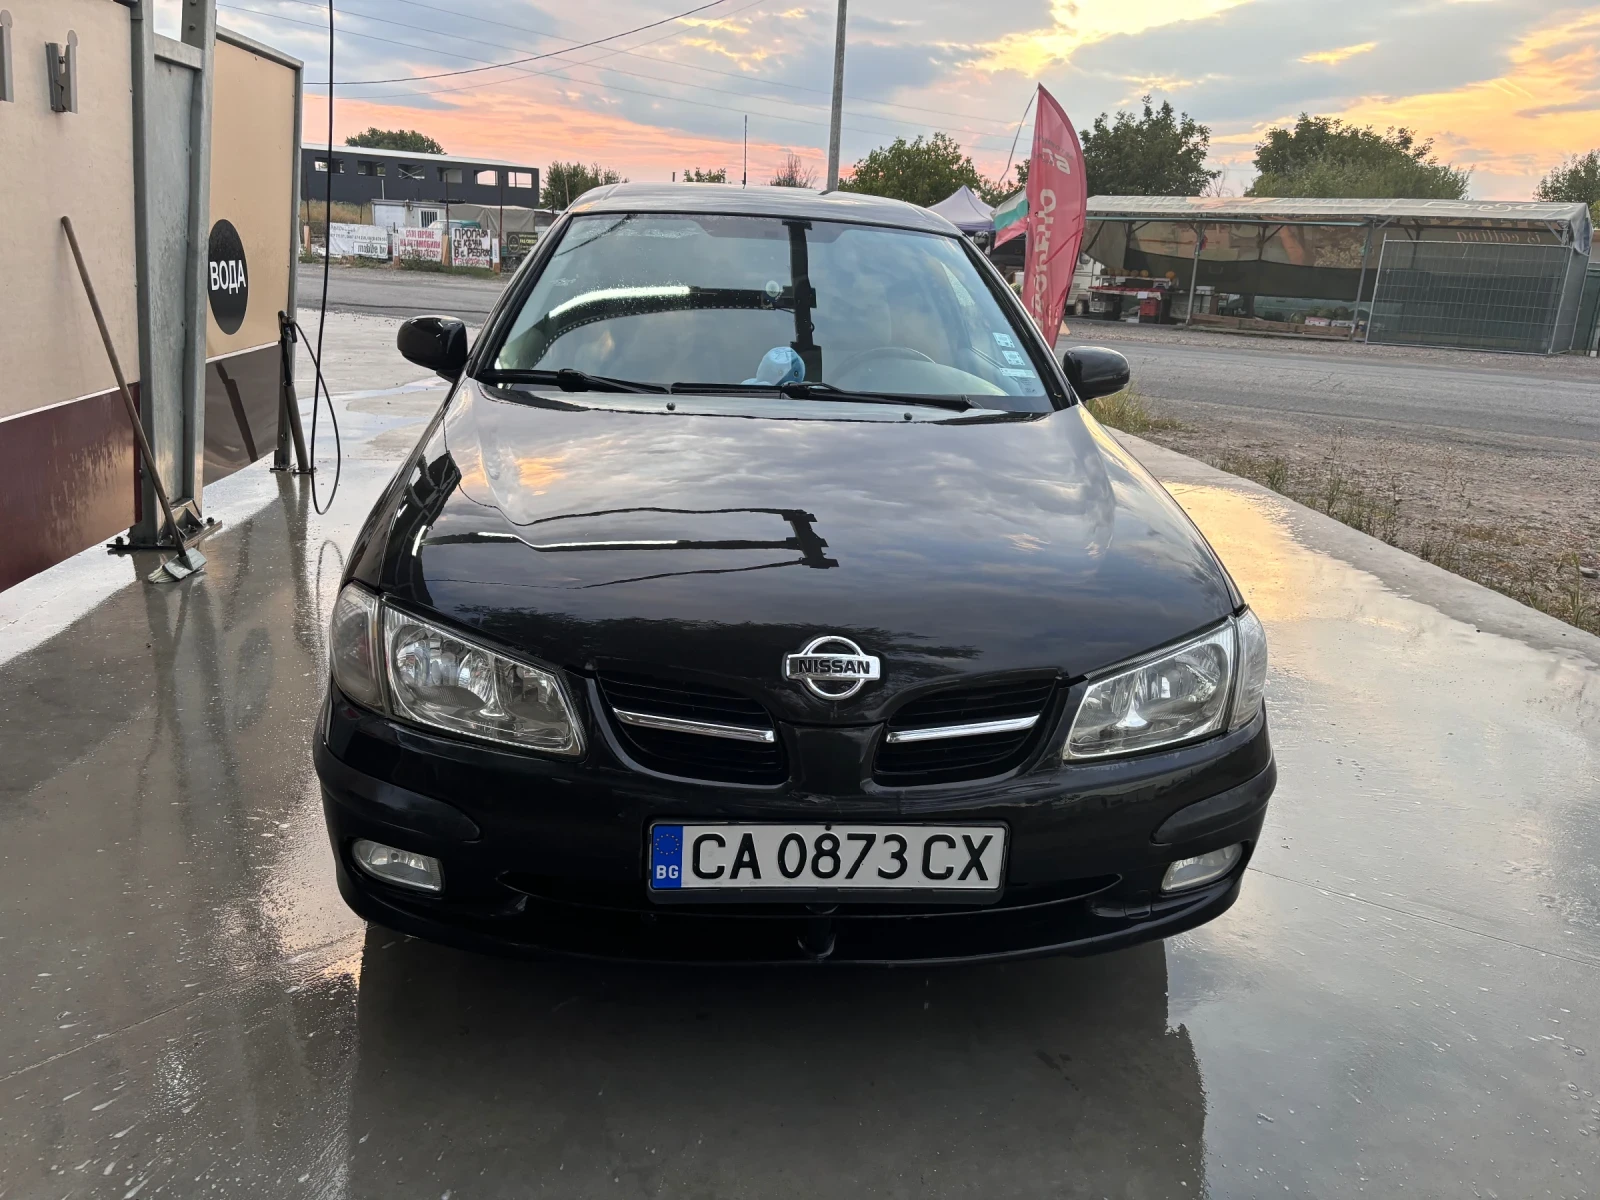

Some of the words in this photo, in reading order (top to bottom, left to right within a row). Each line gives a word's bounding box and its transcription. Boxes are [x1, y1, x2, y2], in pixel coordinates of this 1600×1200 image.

[209, 259, 246, 294] ВОДА
[797, 658, 871, 675] NISSAN
[776, 832, 909, 880] 0873
[655, 865, 679, 880] BG
